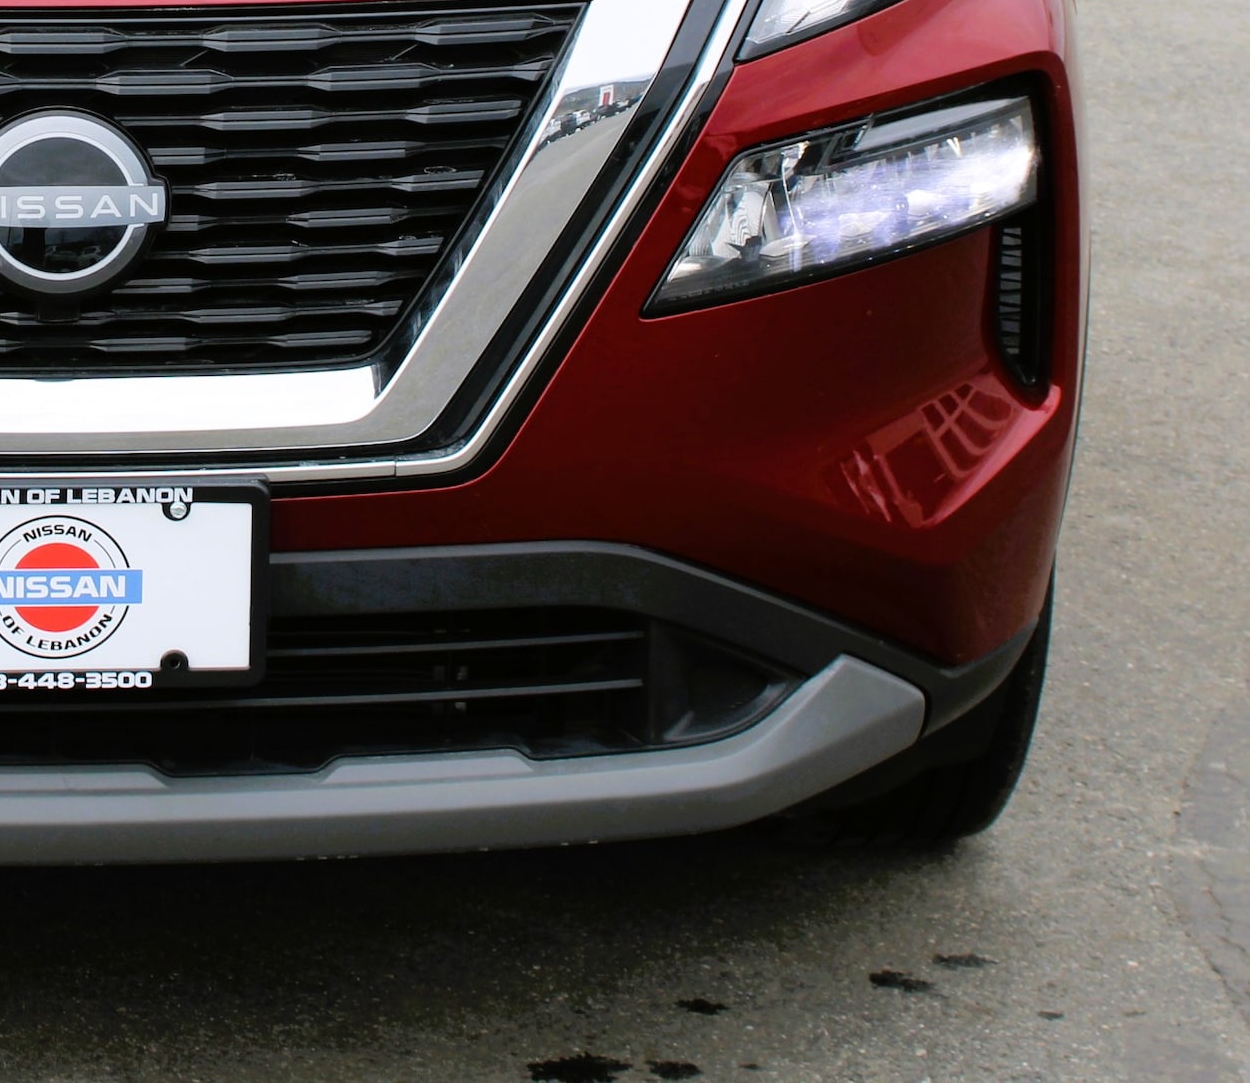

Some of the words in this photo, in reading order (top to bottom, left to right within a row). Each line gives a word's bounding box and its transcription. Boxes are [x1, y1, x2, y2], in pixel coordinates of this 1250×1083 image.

[26, 489, 61, 505] OF
[66, 487, 193, 504] LEBANON
[23, 524, 92, 543] NISSAN
[2, 615, 25, 636] OF
[26, 614, 113, 651] LEBANON
